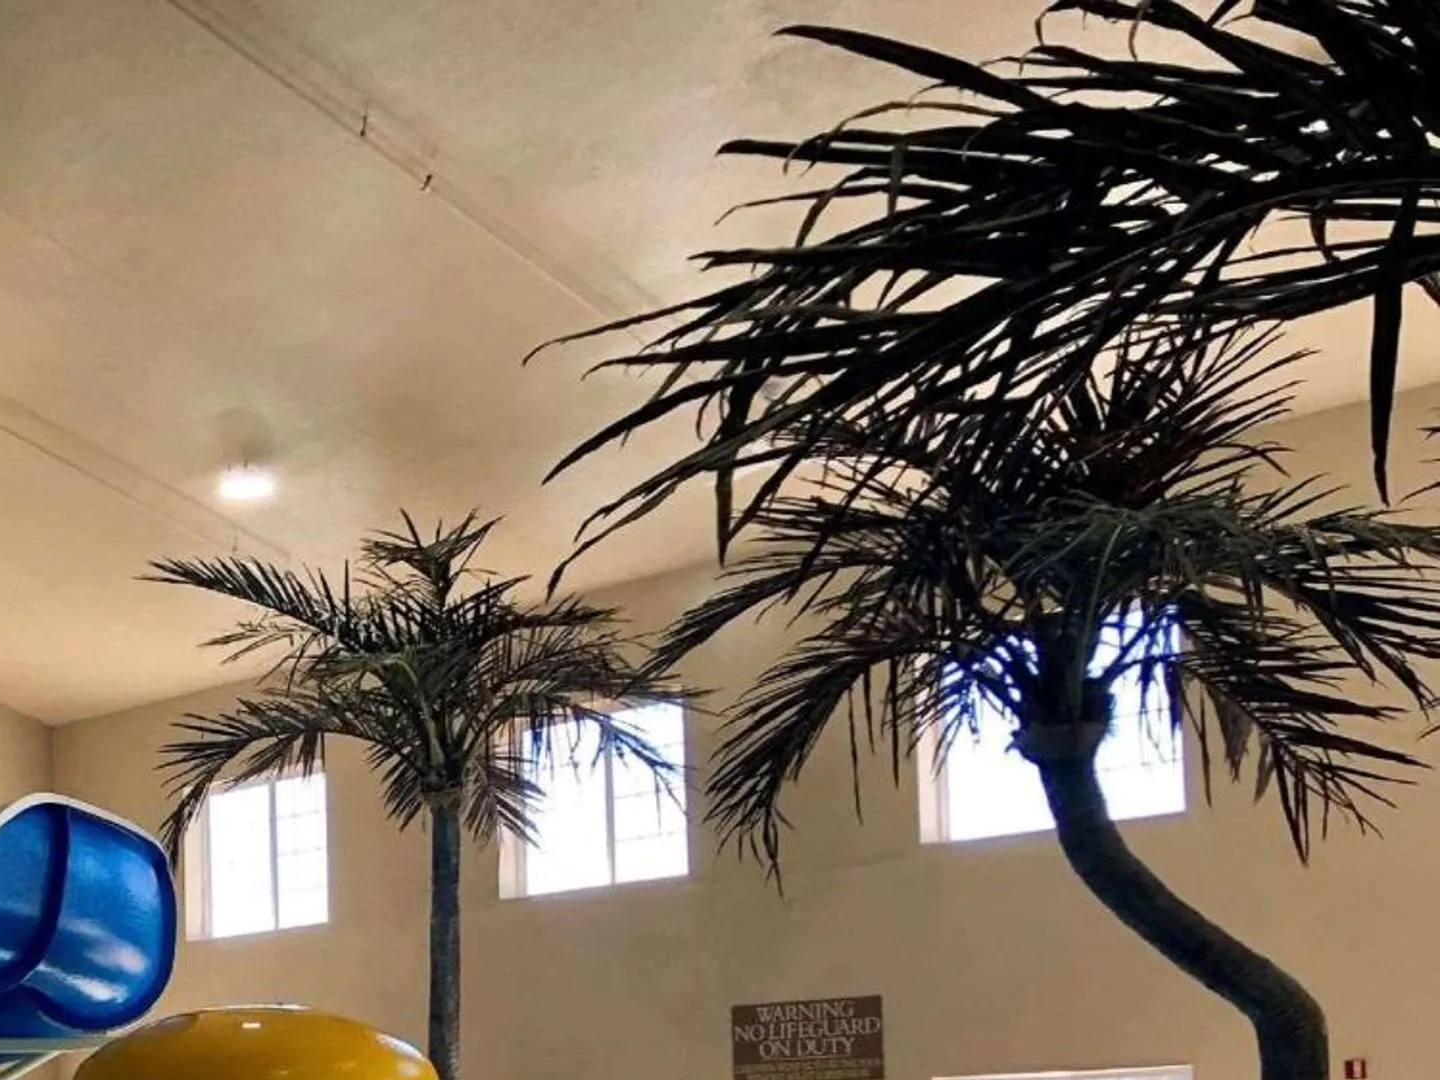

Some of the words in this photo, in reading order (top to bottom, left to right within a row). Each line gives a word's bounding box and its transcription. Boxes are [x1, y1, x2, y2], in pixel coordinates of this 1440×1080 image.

[756, 1001, 855, 1022] WARNING
[734, 1024, 765, 1043] NO
[768, 1017, 881, 1040] LIFEGUARD
[759, 1039, 791, 1060] ON
[797, 1036, 855, 1057] DUTY
